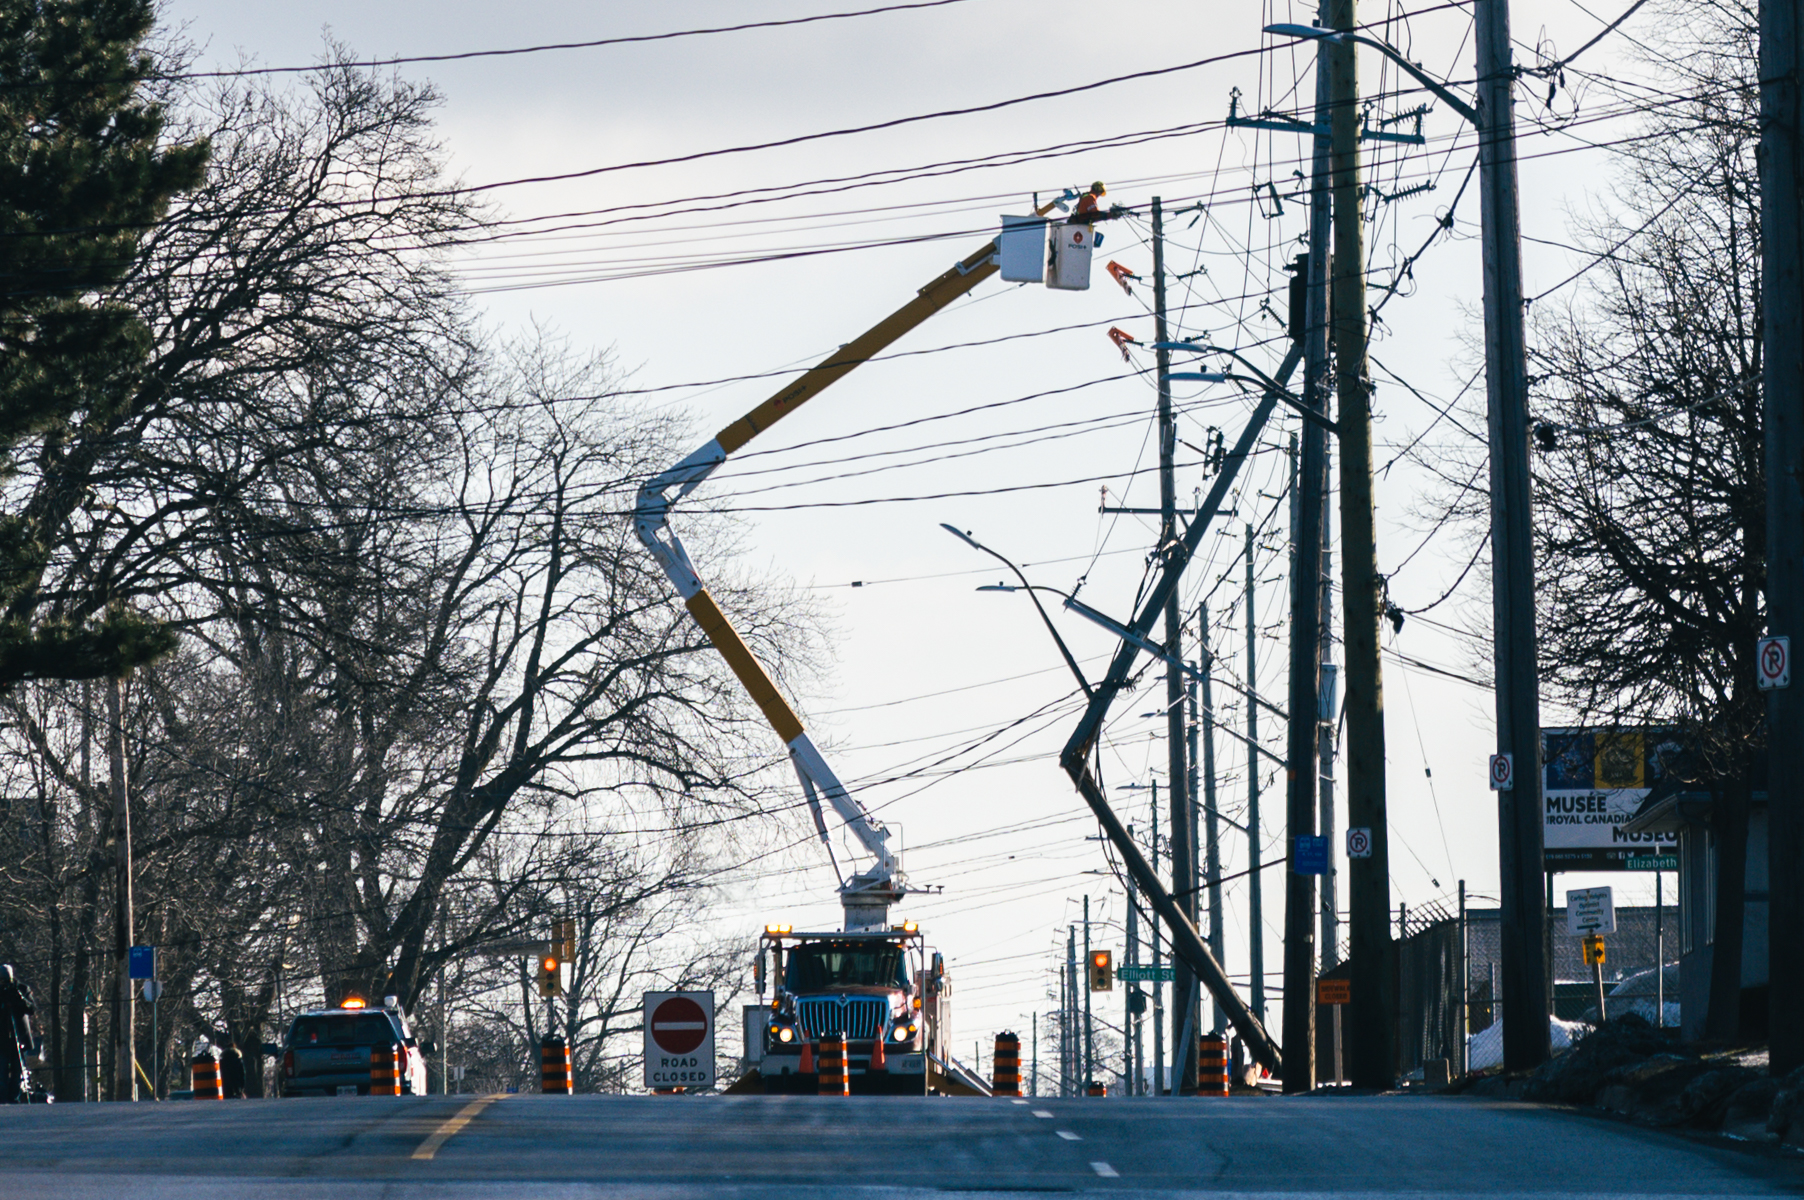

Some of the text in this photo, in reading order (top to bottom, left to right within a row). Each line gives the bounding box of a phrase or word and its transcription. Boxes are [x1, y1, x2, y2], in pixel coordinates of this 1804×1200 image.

[1546, 791, 1607, 813] MUSÉE
[1550, 815, 1582, 824] ROYAL
[1584, 815, 1632, 824] CANADIA
[1612, 827, 1677, 843] MUSEU
[1627, 858, 1677, 869] Elizabeth
[1576, 908, 1604, 917] Community
[1121, 969, 1175, 980] Elliott St
[660, 1057, 698, 1068] ROAD
[653, 1072, 706, 1082] CLOSED
